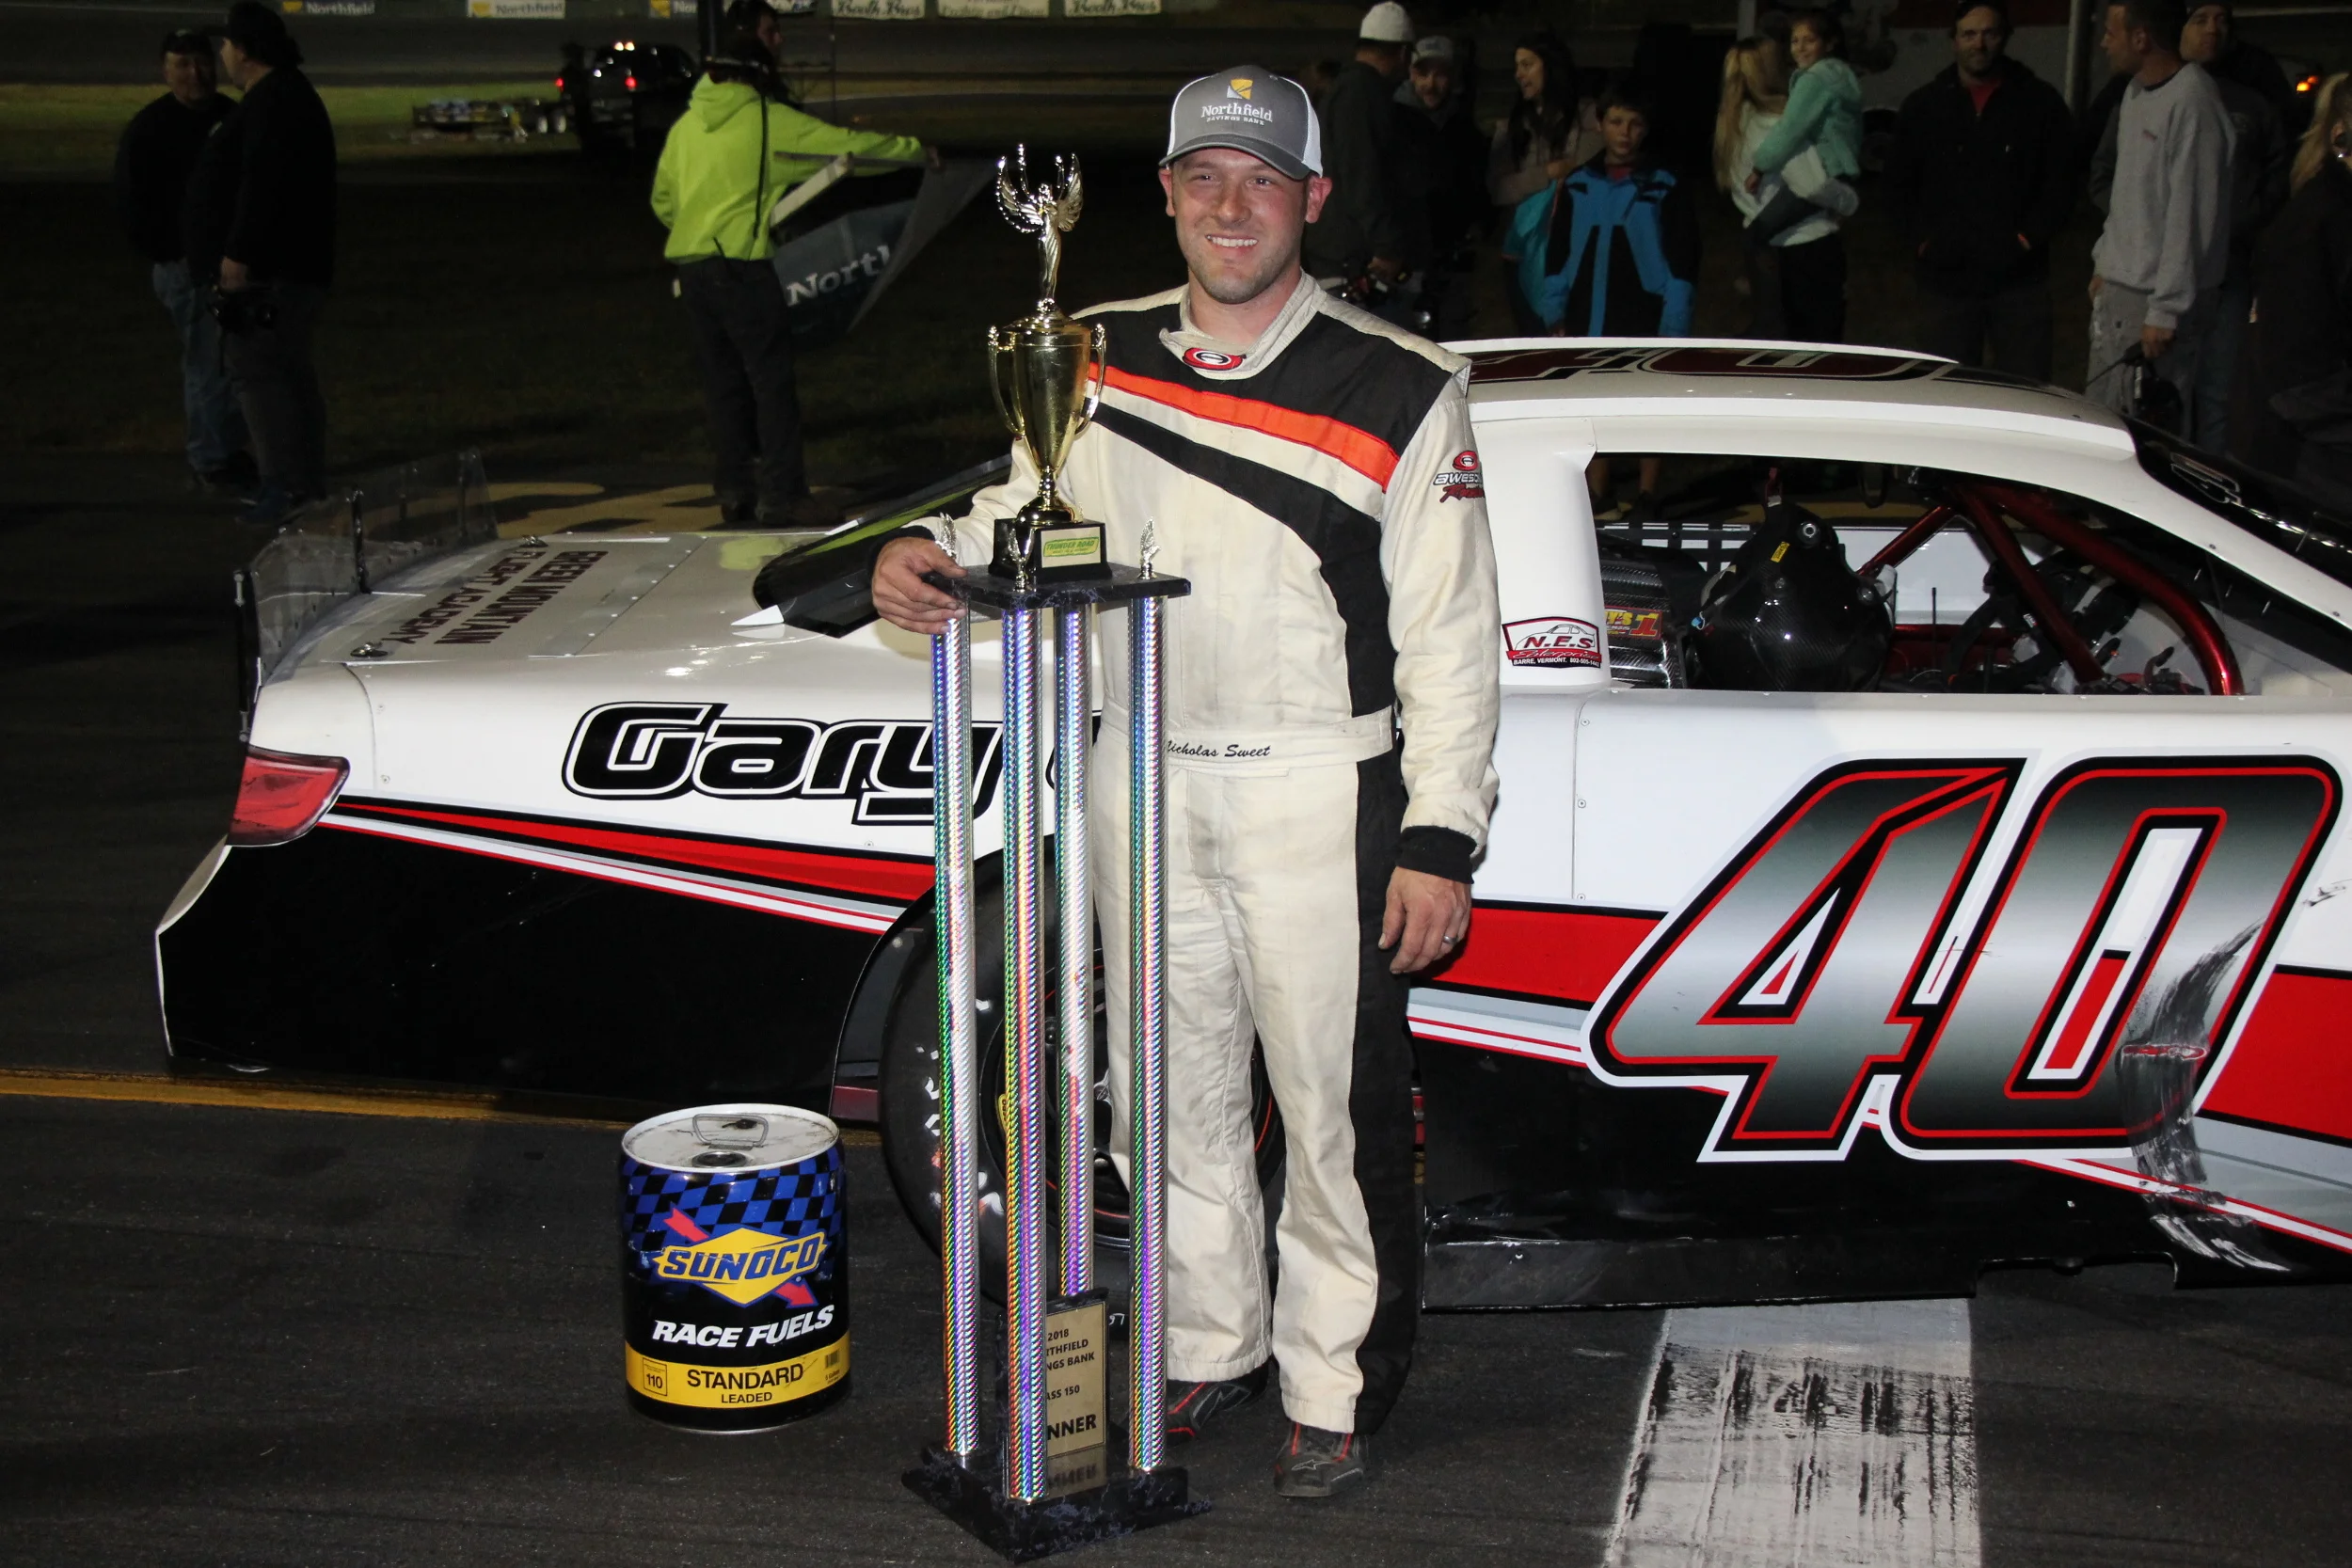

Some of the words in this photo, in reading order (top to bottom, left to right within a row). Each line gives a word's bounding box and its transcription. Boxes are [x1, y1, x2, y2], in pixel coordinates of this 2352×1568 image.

[1200, 103, 1273, 122] Northfield
[1243, 117, 1264, 126] BANK
[1046, 542, 1076, 550] THUNDER
[521, 550, 610, 583] GREEN
[381, 586, 492, 644] ACADEMY
[434, 585, 566, 644] MOUNTAIN
[1224, 743, 1271, 757] Sweet
[562, 702, 1004, 826] Gary
[1586, 752, 2344, 1159] 40
[662, 1237, 821, 1281] SUNOCO
[652, 1320, 744, 1348] RACE
[745, 1305, 835, 1348] FUELS
[1047, 1328, 1070, 1342] 2018
[1067, 1352, 1095, 1367] BANK
[646, 1373, 663, 1389] 110
[687, 1363, 804, 1390] STANDARD
[721, 1392, 772, 1404] LEADED
[1064, 1385, 1080, 1396] 150
